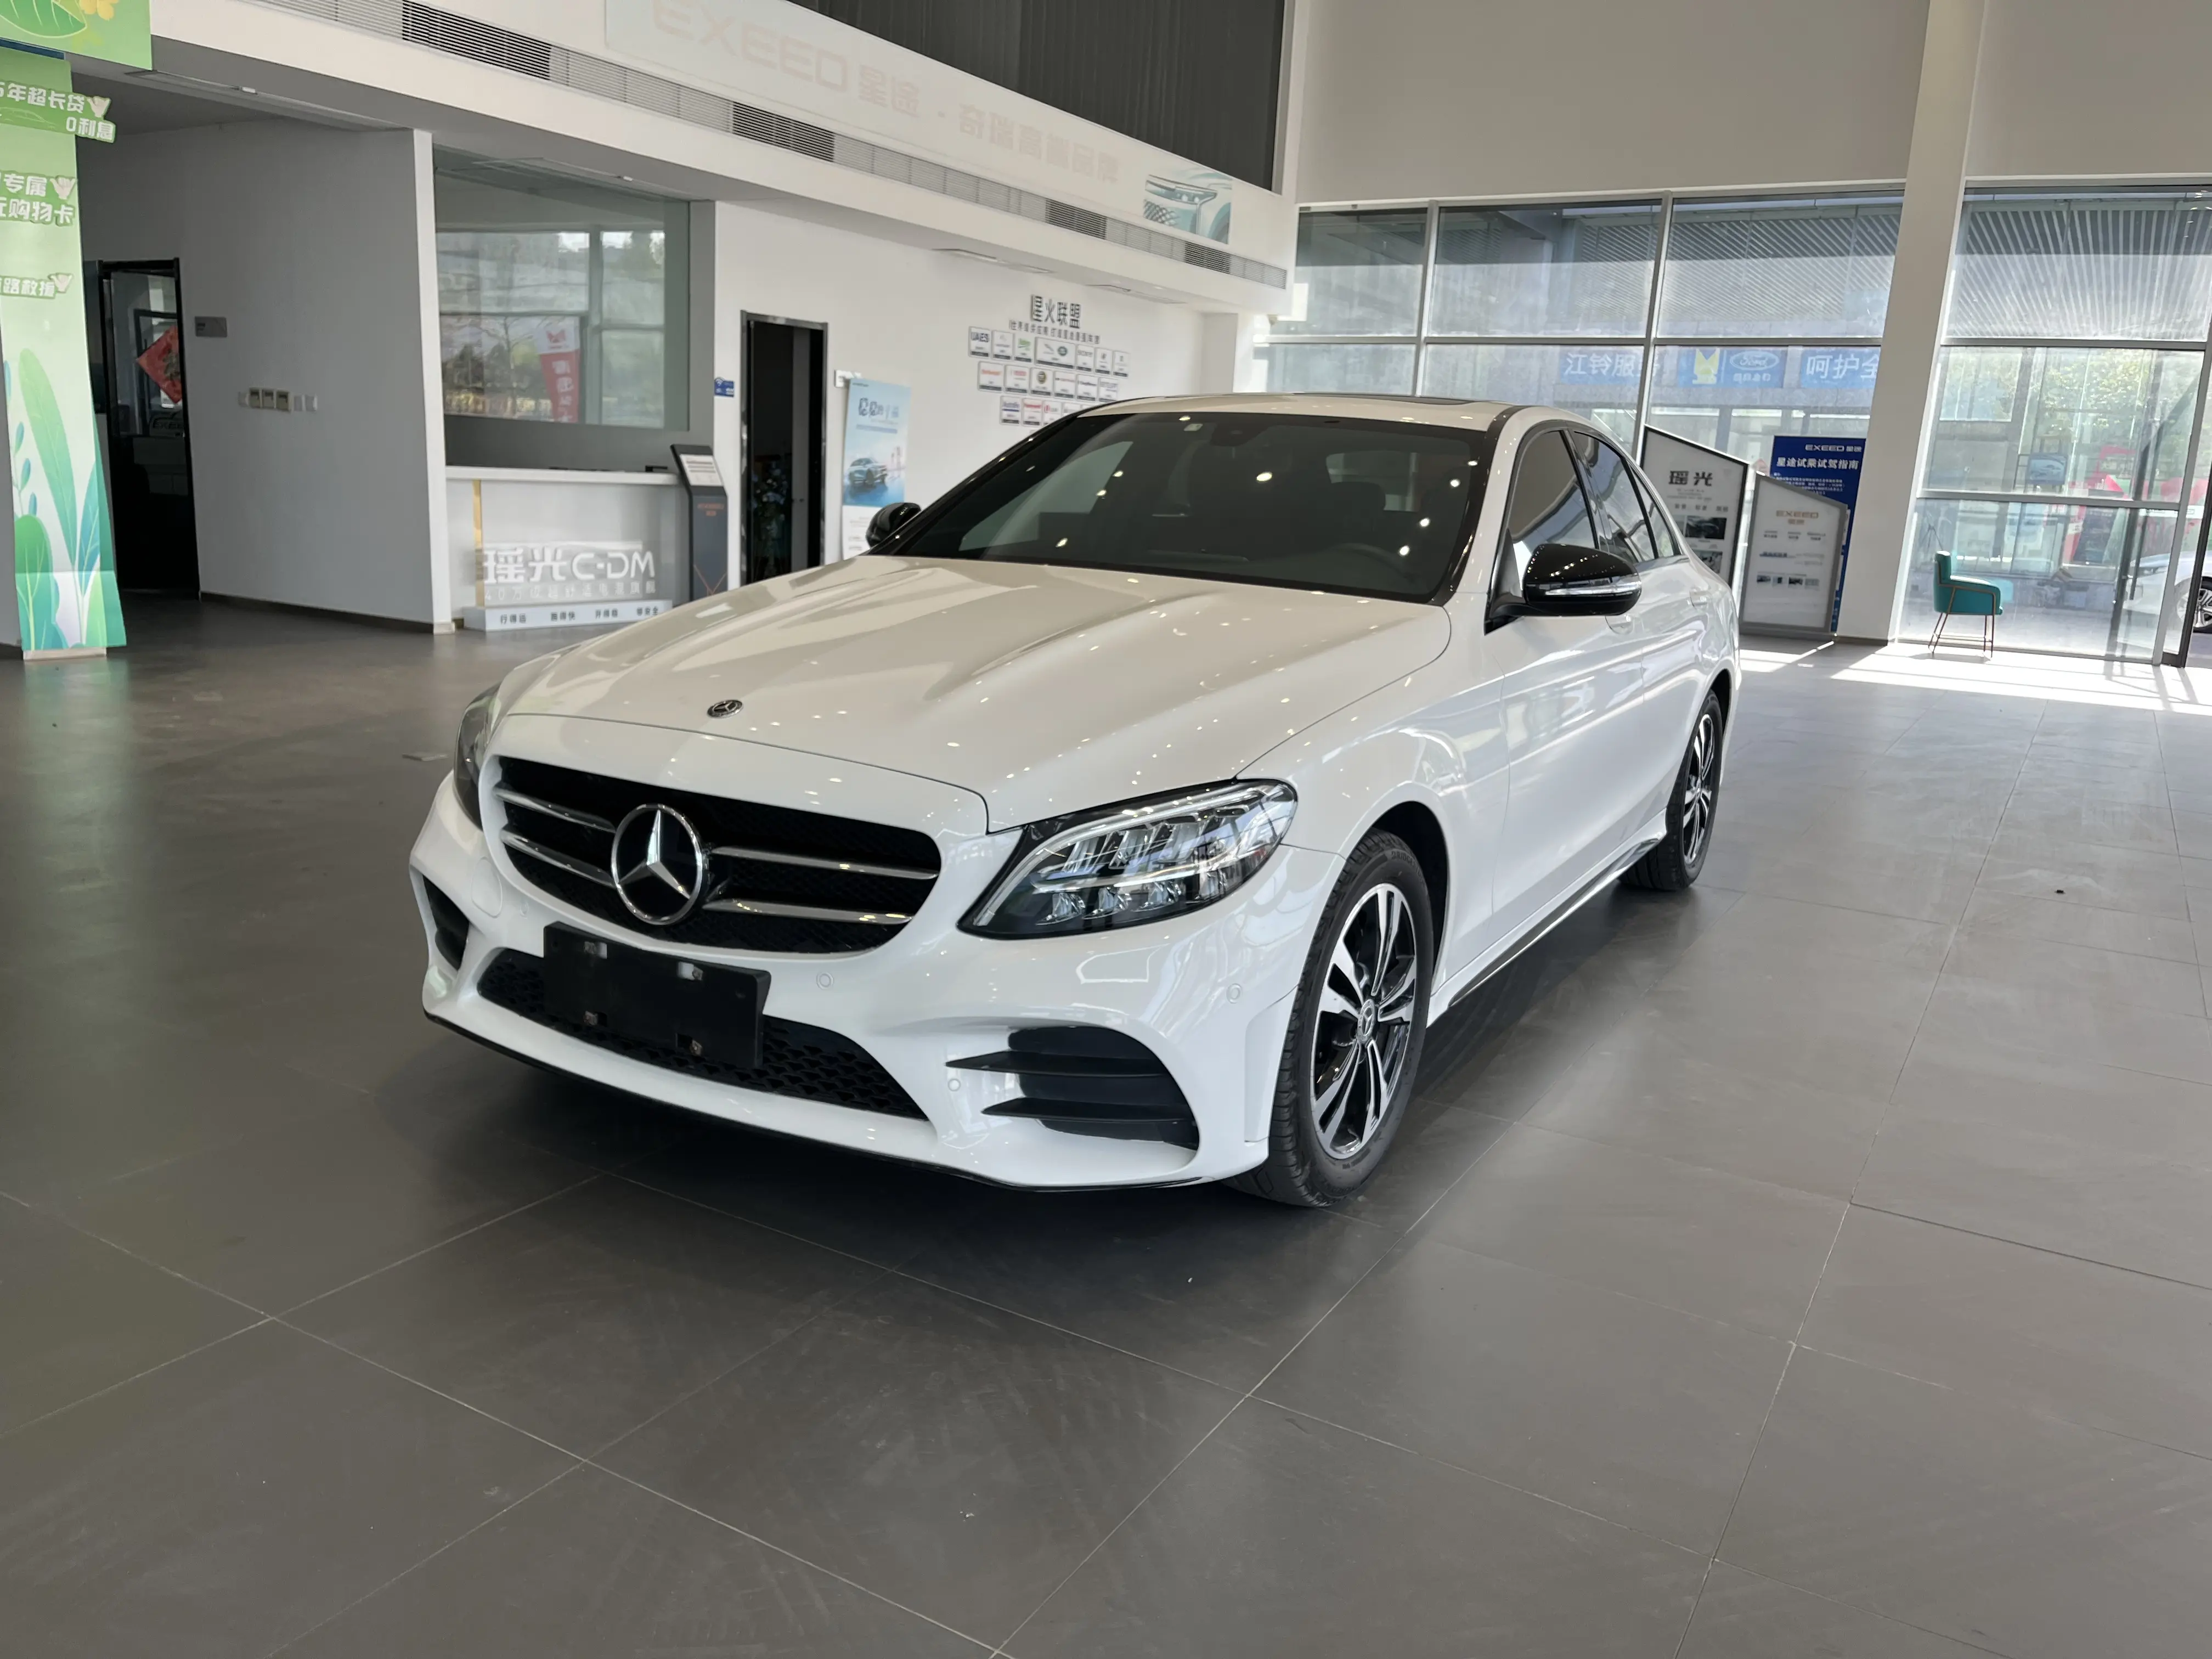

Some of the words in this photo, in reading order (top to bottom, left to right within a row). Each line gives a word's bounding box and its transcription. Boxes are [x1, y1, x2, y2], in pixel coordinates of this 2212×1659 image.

[653, 0, 847, 92] EXEED
[859, 65, 919, 118] 星途
[66, 117, 114, 140] 0利息
[0, 173, 47, 196] 专属
[0, 277, 55, 297] 路救援
[1031, 295, 1081, 329] 星火联盟
[1776, 457, 1860, 470] 星途试乘试驾指南
[1668, 470, 1713, 487] 瑶光
